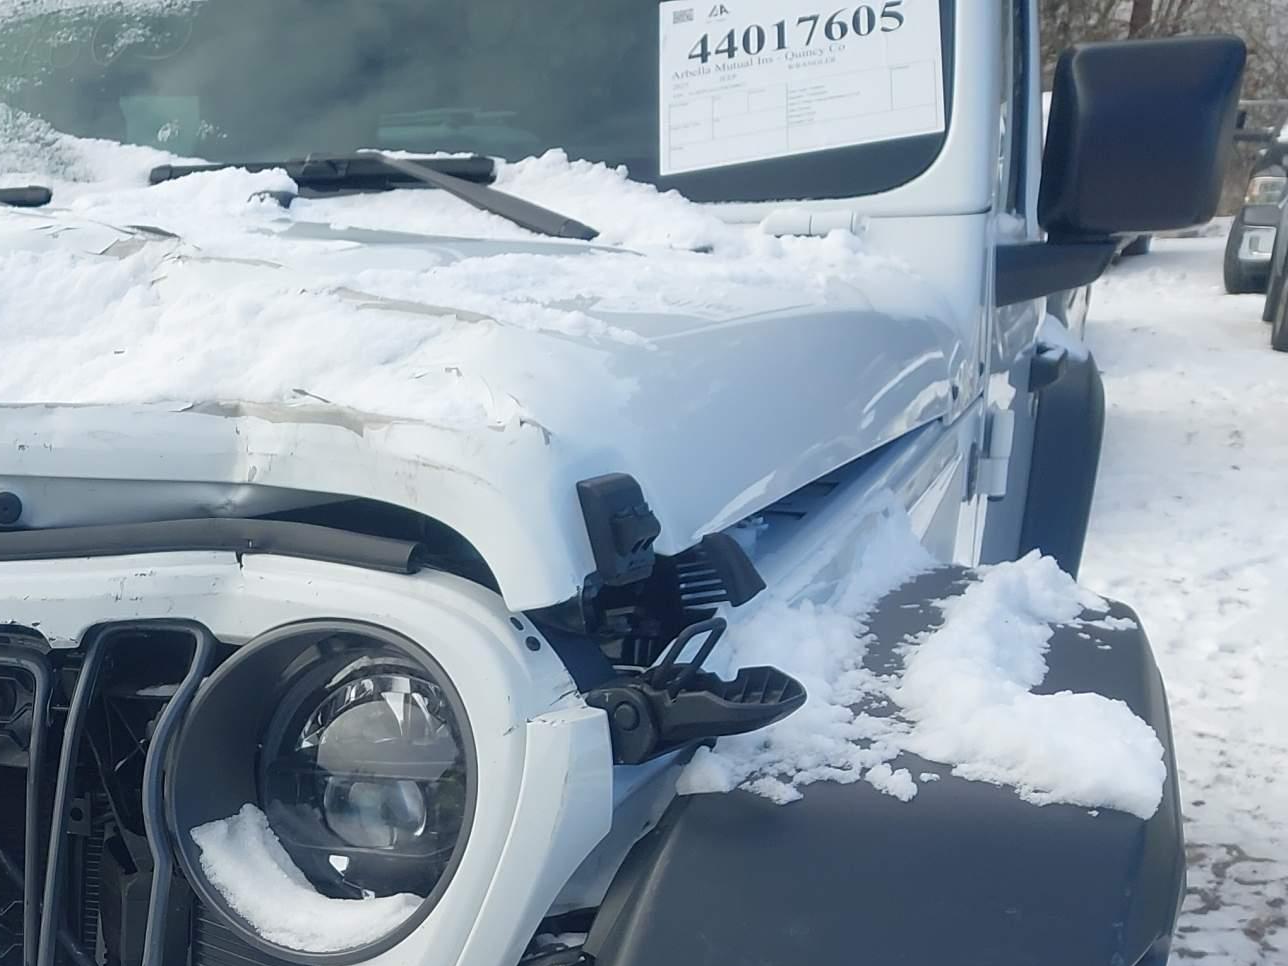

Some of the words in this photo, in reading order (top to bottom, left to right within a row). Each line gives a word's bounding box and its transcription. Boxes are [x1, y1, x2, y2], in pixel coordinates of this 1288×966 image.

[688, 0, 906, 64] 44017605
[672, 66, 711, 81] Arbella
[715, 58, 753, 72] Mutual
[758, 56, 773, 66] Ins
[829, 42, 846, 52] Co
